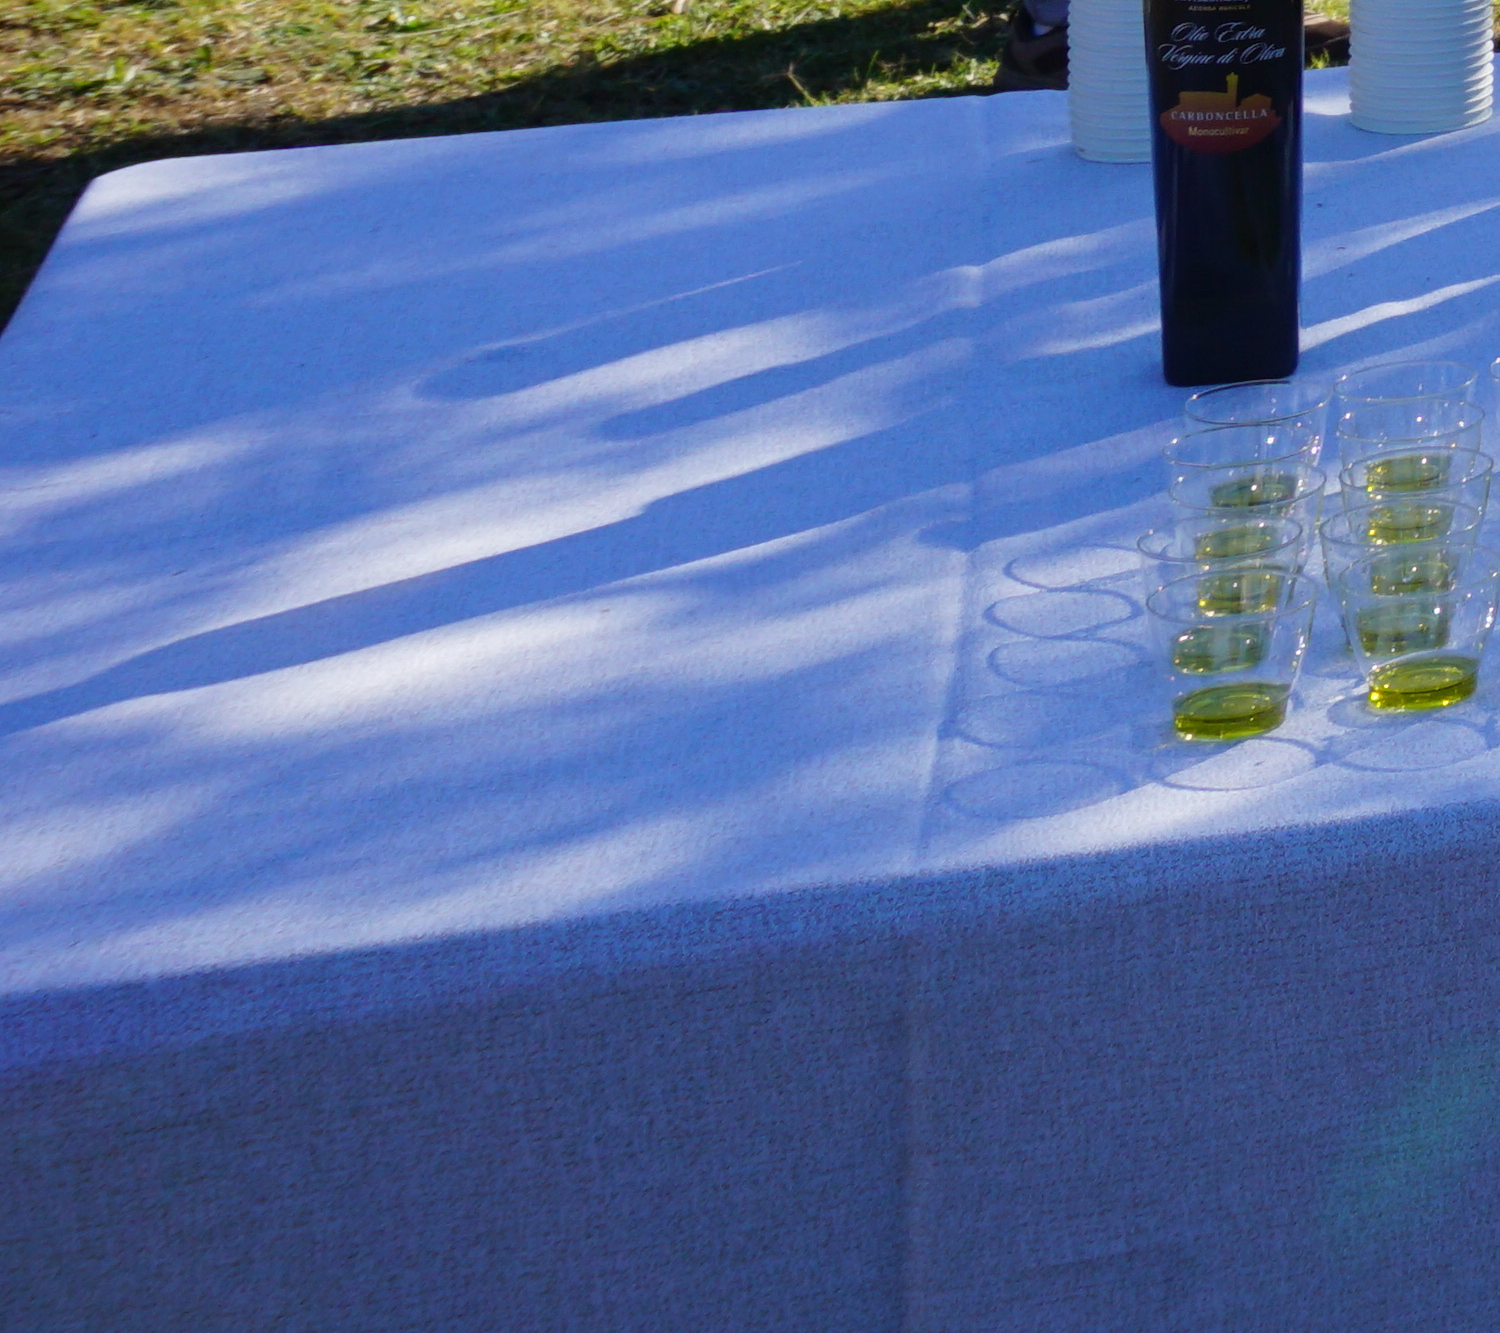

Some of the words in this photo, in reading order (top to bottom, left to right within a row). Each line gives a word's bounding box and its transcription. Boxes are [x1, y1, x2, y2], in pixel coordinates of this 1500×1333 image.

[1171, 21, 1210, 43] Olio
[1215, 21, 1267, 43] Extra
[1158, 43, 1215, 71] Vergine
[1216, 50, 1239, 65] di
[1240, 41, 1287, 65] Oliva
[1171, 109, 1268, 121] CARBONCELLA
[1188, 126, 1249, 136] Monocultivar
